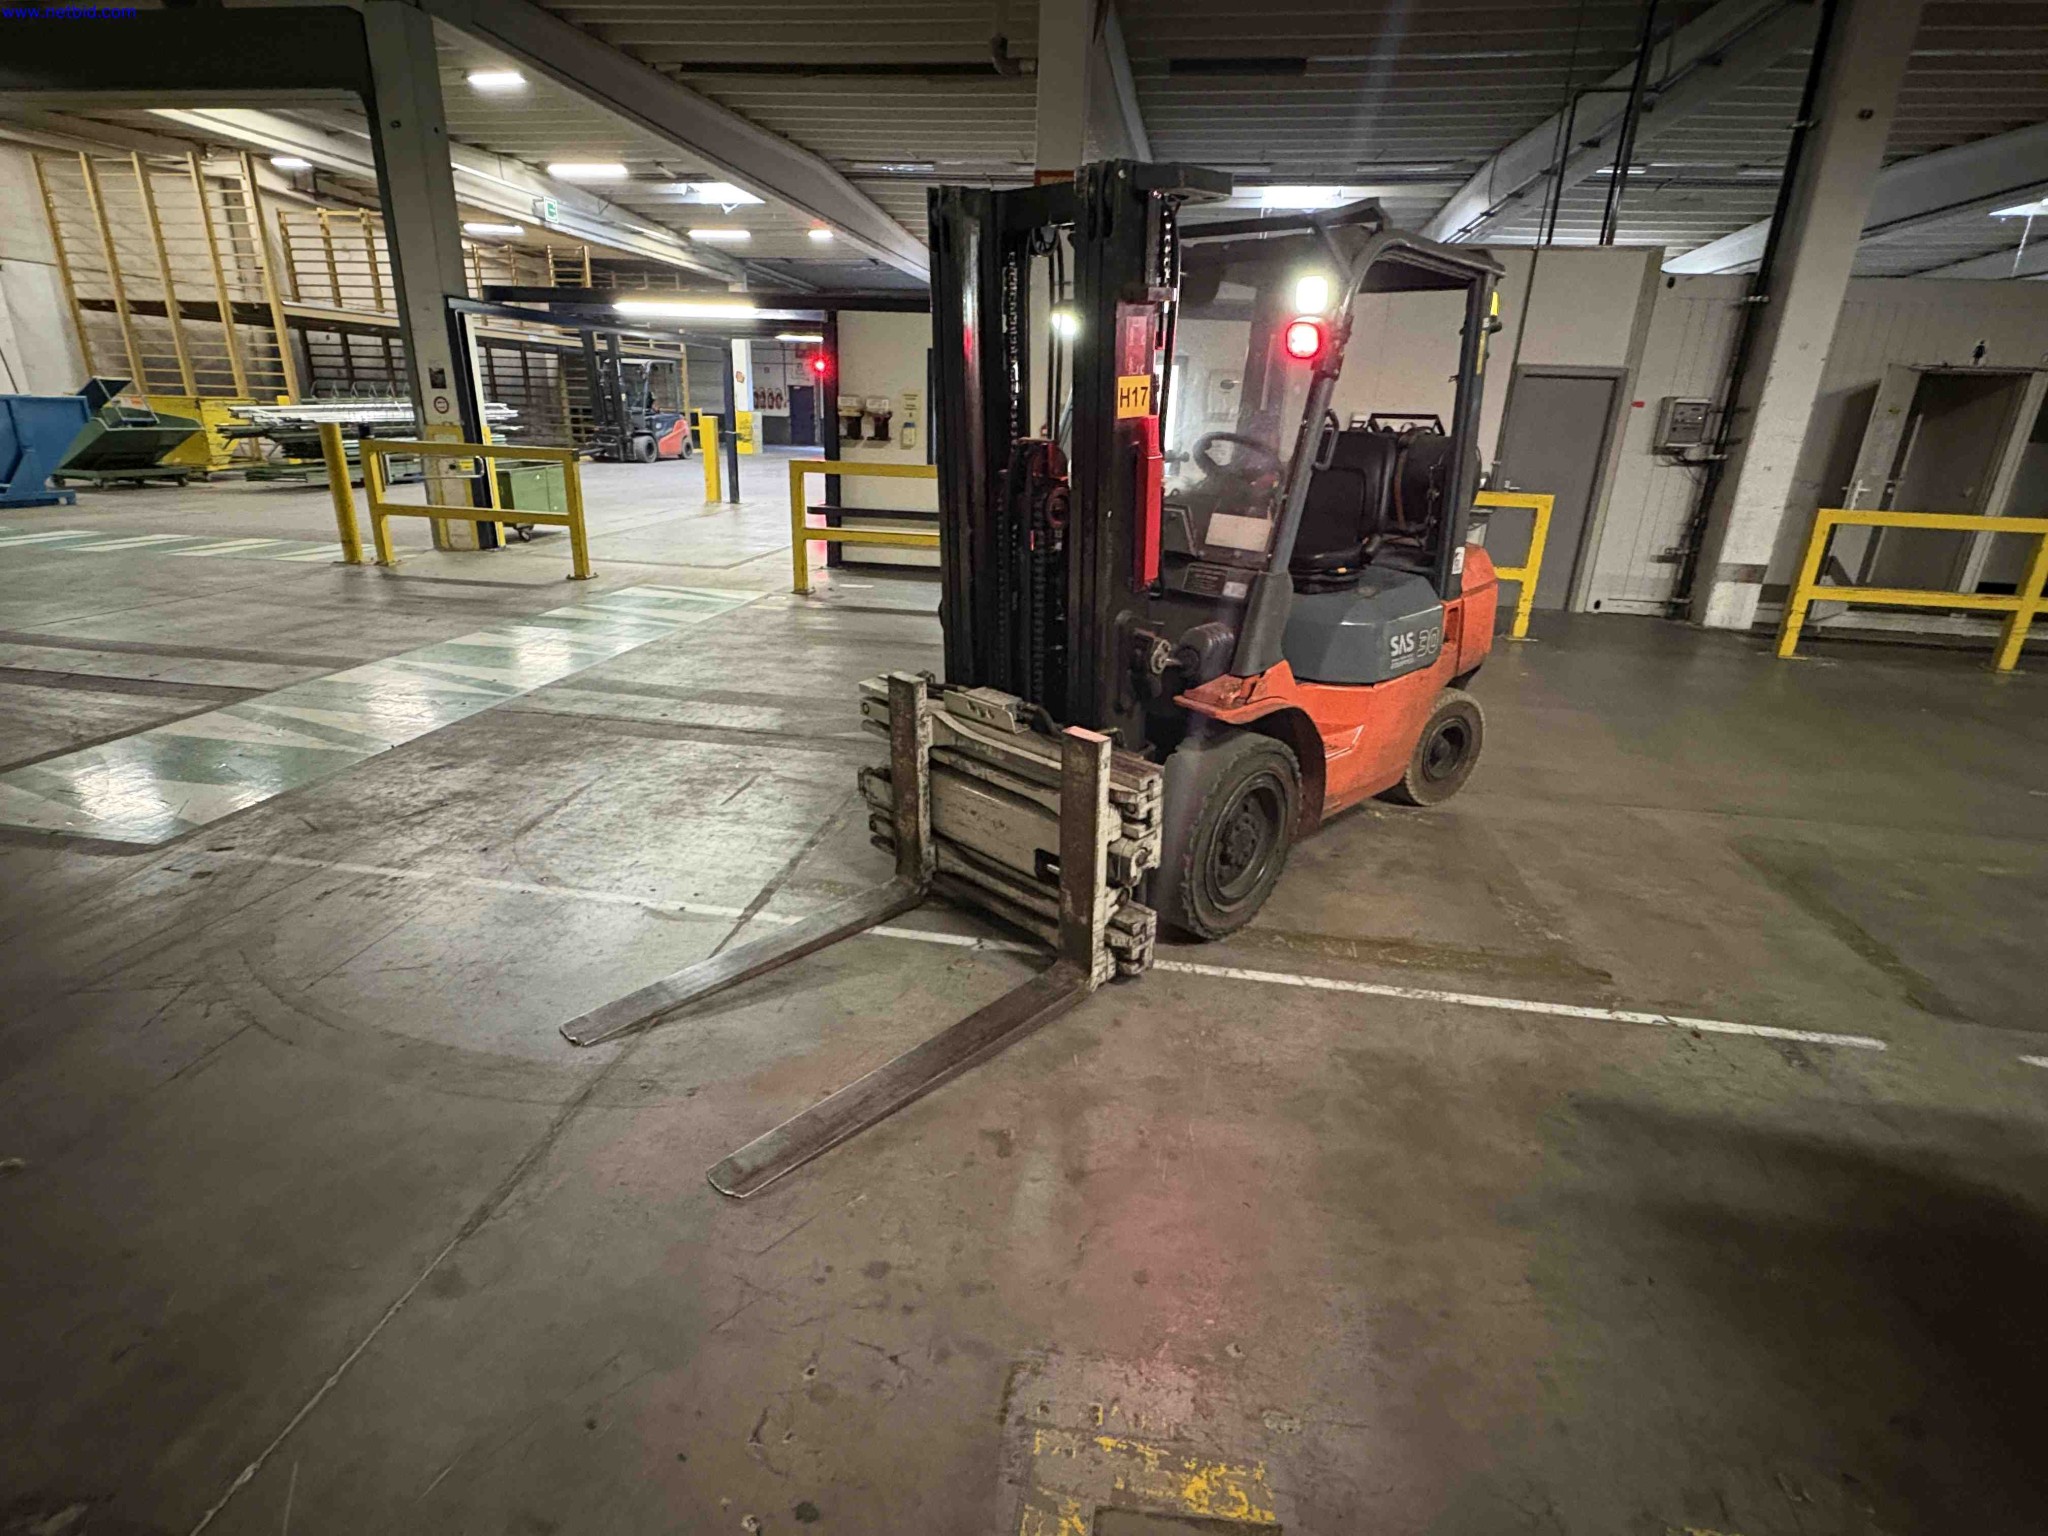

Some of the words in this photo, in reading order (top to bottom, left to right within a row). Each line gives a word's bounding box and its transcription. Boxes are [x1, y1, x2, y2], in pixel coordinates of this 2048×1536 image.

[1119, 386, 1149, 409] H17
[1390, 631, 1415, 657] SAS
[1417, 626, 1440, 657] 30
